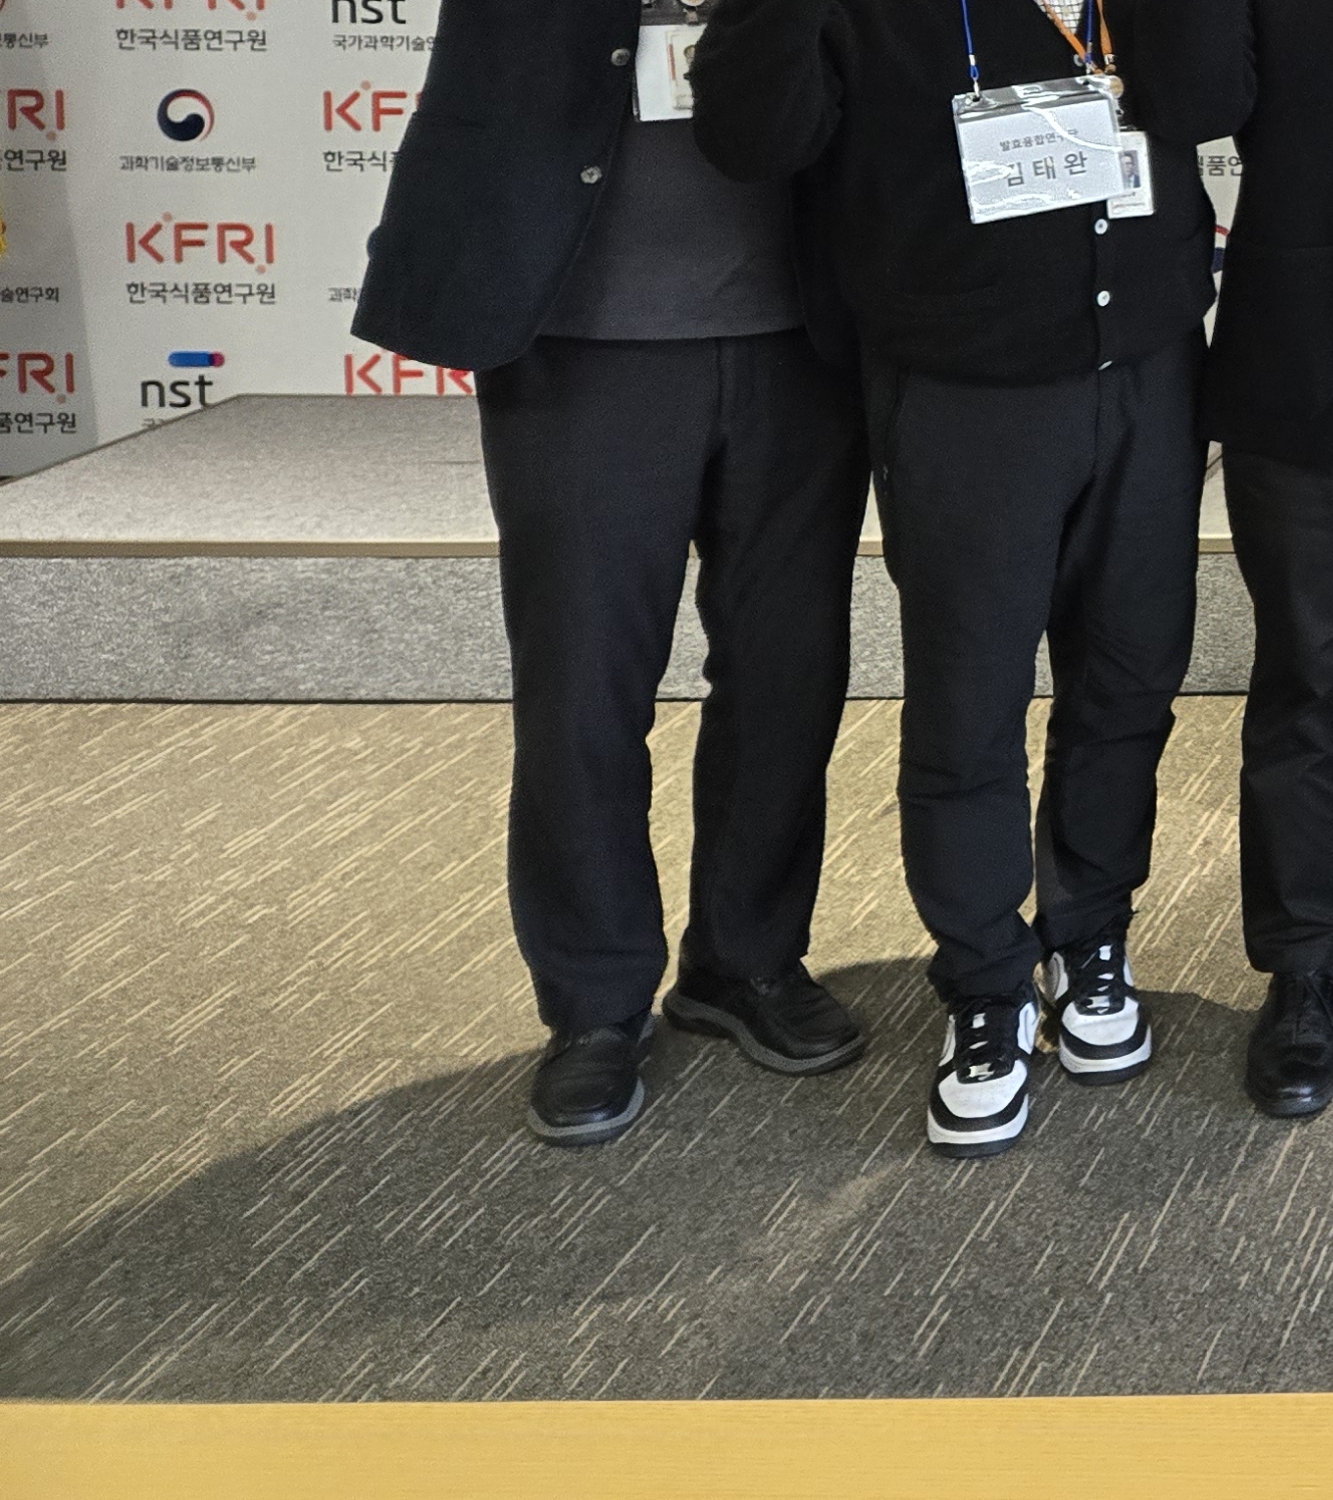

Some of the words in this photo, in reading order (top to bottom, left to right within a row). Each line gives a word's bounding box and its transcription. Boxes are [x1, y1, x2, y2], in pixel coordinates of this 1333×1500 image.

[116, 28, 266, 51] 한국식품연구원
[120, 156, 255, 172] 과학기술정보통신부
[127, 223, 274, 262] KFRI
[126, 282, 275, 304] 한국식품연구원
[140, 375, 213, 408] nst
